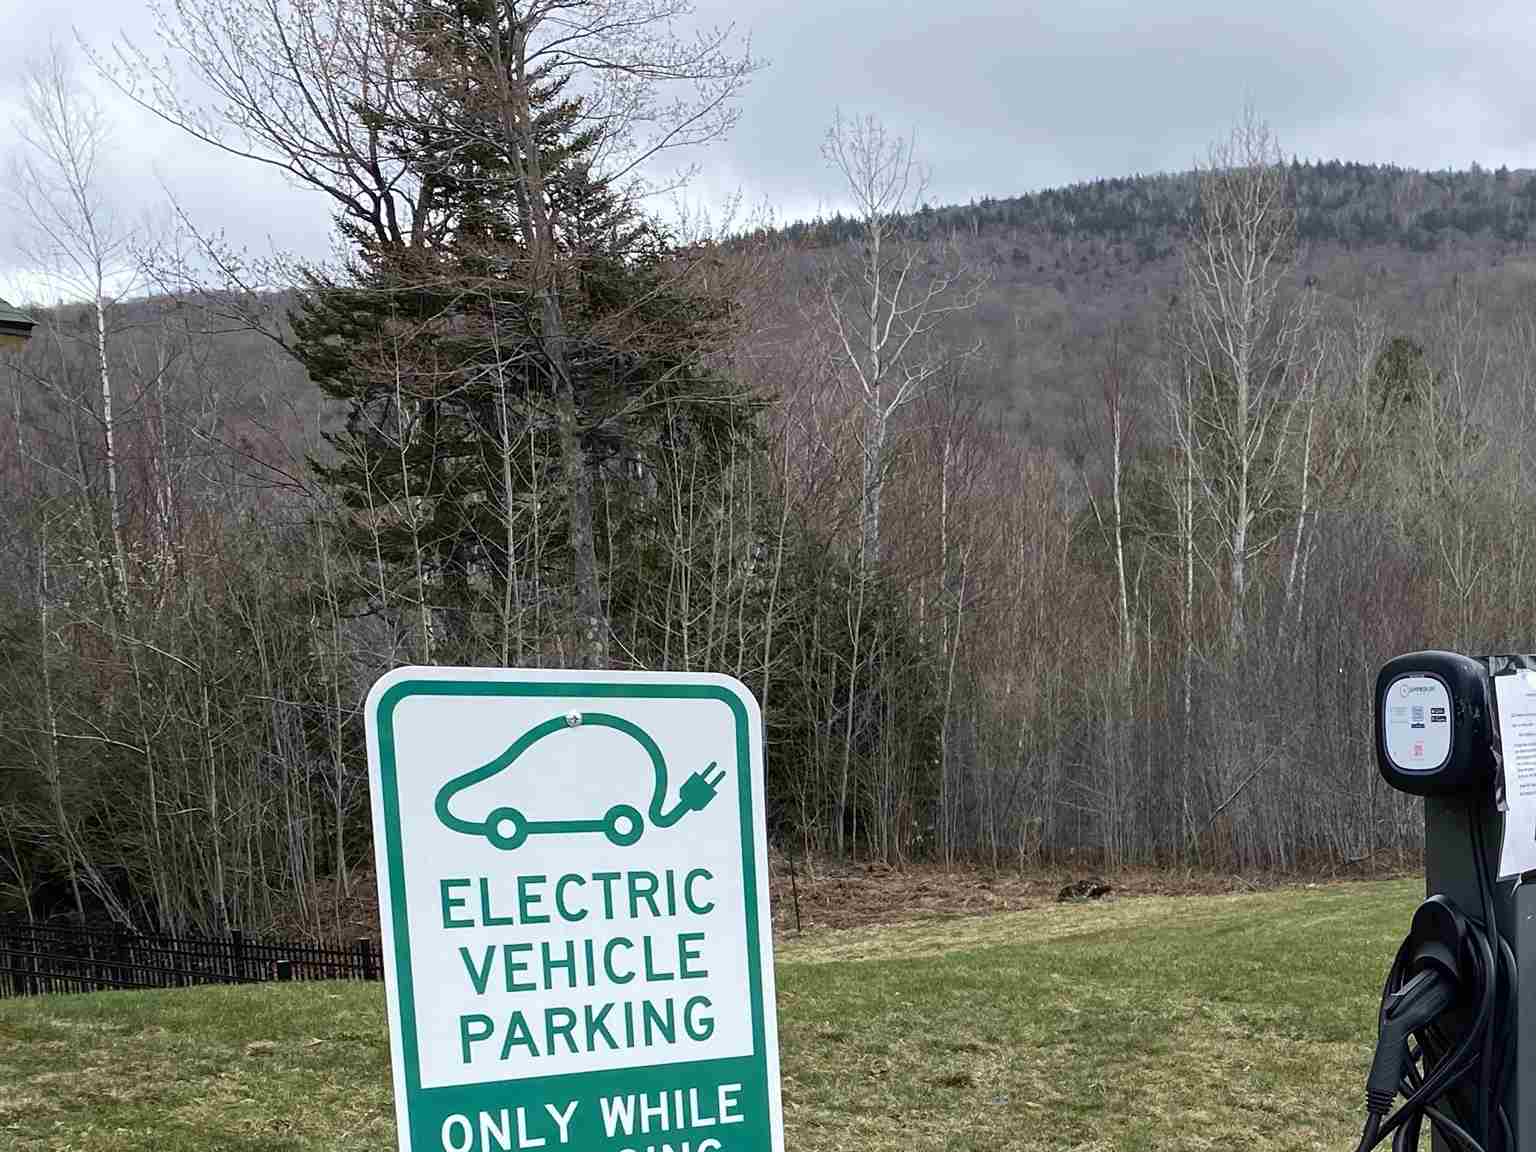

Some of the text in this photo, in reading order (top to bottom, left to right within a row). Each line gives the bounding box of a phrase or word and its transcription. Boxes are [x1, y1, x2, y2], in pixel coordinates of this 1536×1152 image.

[439, 868, 716, 929] ELECTRIC
[459, 932, 708, 995] VEHICLE
[459, 995, 716, 1064] PARKING
[599, 1083, 745, 1137] WHILE
